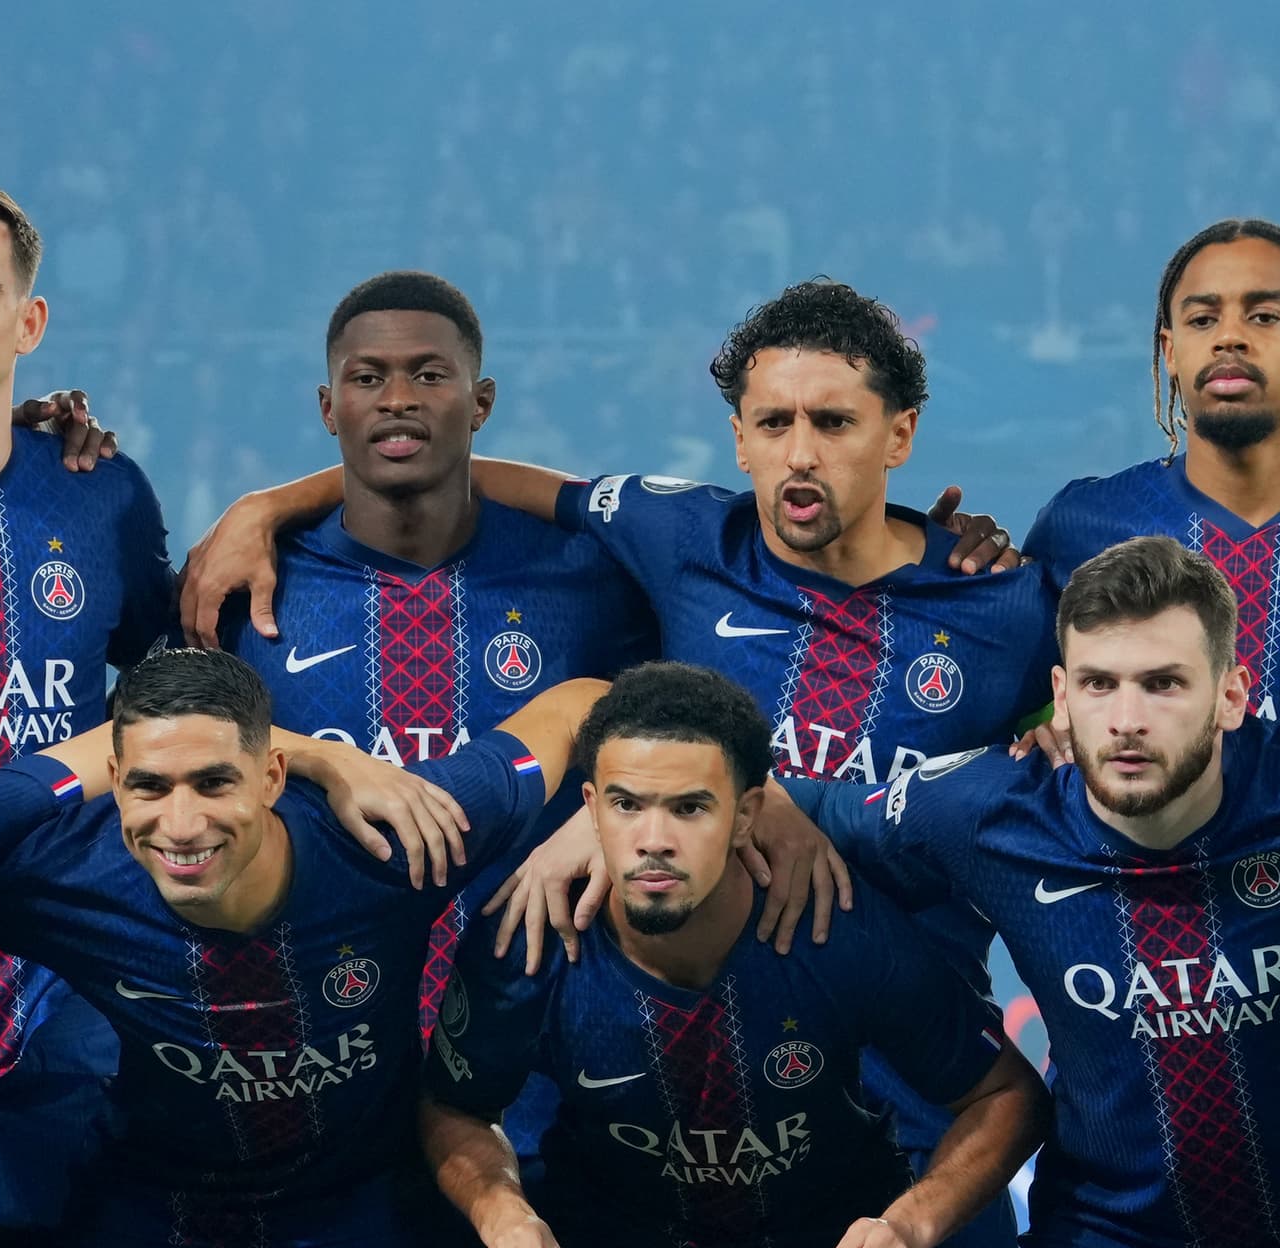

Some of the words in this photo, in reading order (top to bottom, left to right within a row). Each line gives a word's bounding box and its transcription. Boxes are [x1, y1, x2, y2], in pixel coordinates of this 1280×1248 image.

[40, 565, 74, 579] PARIS
[494, 635, 531, 649] PARIS
[920, 657, 956, 674] PARIS
[770, 715, 927, 784] ATAR
[1239, 853, 1280, 869] PARIS
[330, 960, 368, 979] PARIS
[151, 1023, 374, 1084] QATAR
[772, 1043, 811, 1059] PARIS
[215, 1045, 377, 1103] AIRWAYS
[608, 1112, 811, 1165] QATAR
[660, 1137, 811, 1186] AIRWAYS
